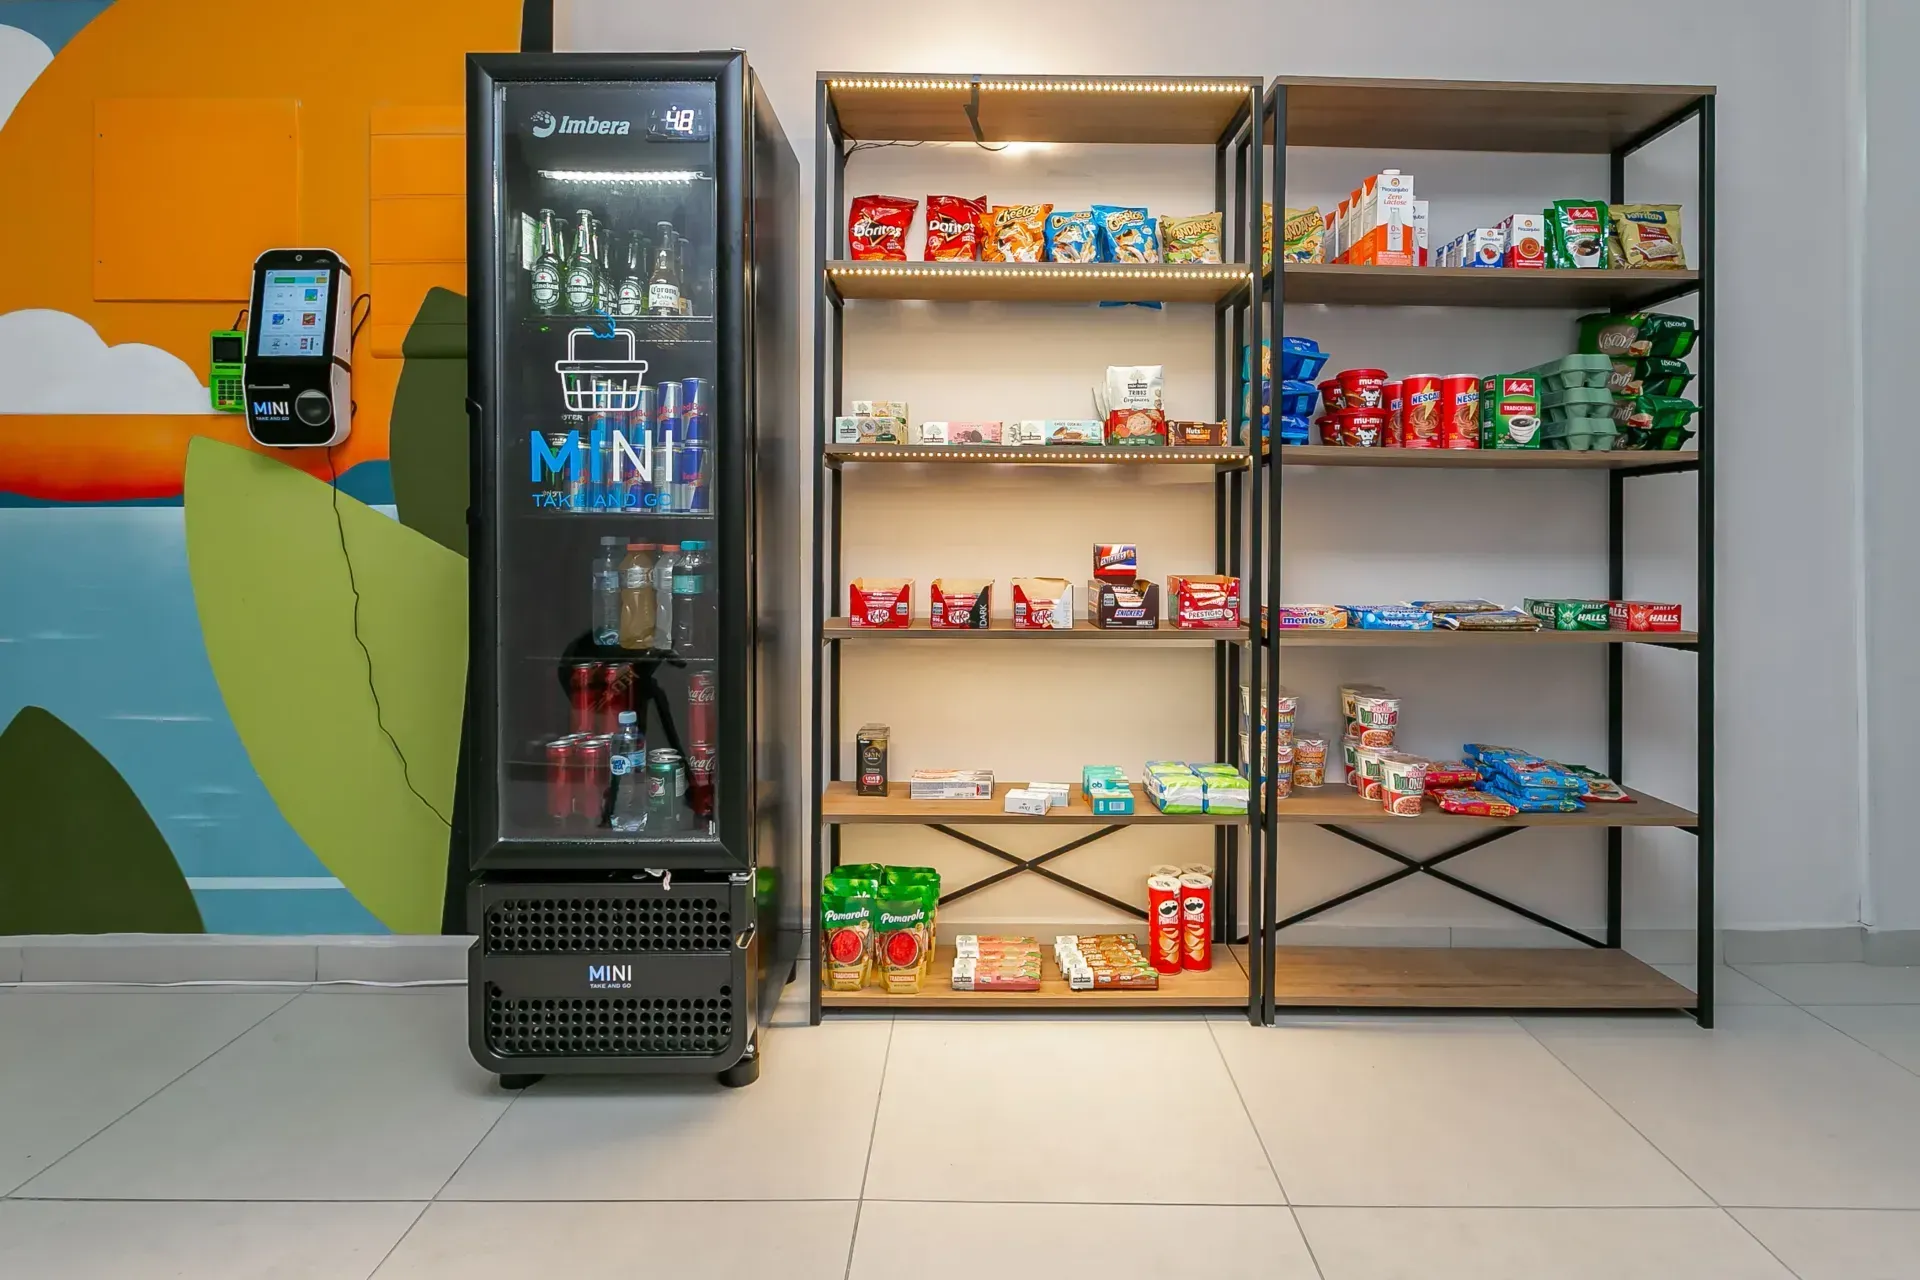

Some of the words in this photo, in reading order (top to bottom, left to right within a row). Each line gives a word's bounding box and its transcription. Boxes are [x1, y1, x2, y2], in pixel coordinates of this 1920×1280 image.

[558, 116, 630, 135] Imbera
[666, 109, 694, 131] 48
[996, 204, 1042, 224] Cheetos
[853, 224, 902, 237] Doritos
[929, 220, 975, 234] Doritos
[1285, 212, 1320, 241] ANDANGO
[651, 286, 677, 297] Corona
[1507, 381, 1532, 392] Melitta
[254, 401, 289, 415] MINI
[530, 430, 673, 482] MINI
[532, 493, 586, 507] TAKE
[593, 493, 637, 507] AND
[644, 493, 673, 507] GO
[1101, 553, 1126, 565] SNICKERS
[979, 604, 988, 626] DARK
[1116, 609, 1144, 617] SNICKERS
[1577, 613, 1607, 622] HALLS
[1609, 606, 1628, 618] ALLS
[1649, 614, 1678, 622] HALLS
[1283, 616, 1325, 625] mentos
[825, 907, 870, 921] Pomarola
[881, 908, 925, 924] Pomarola
[589, 965, 632, 981] MINI
